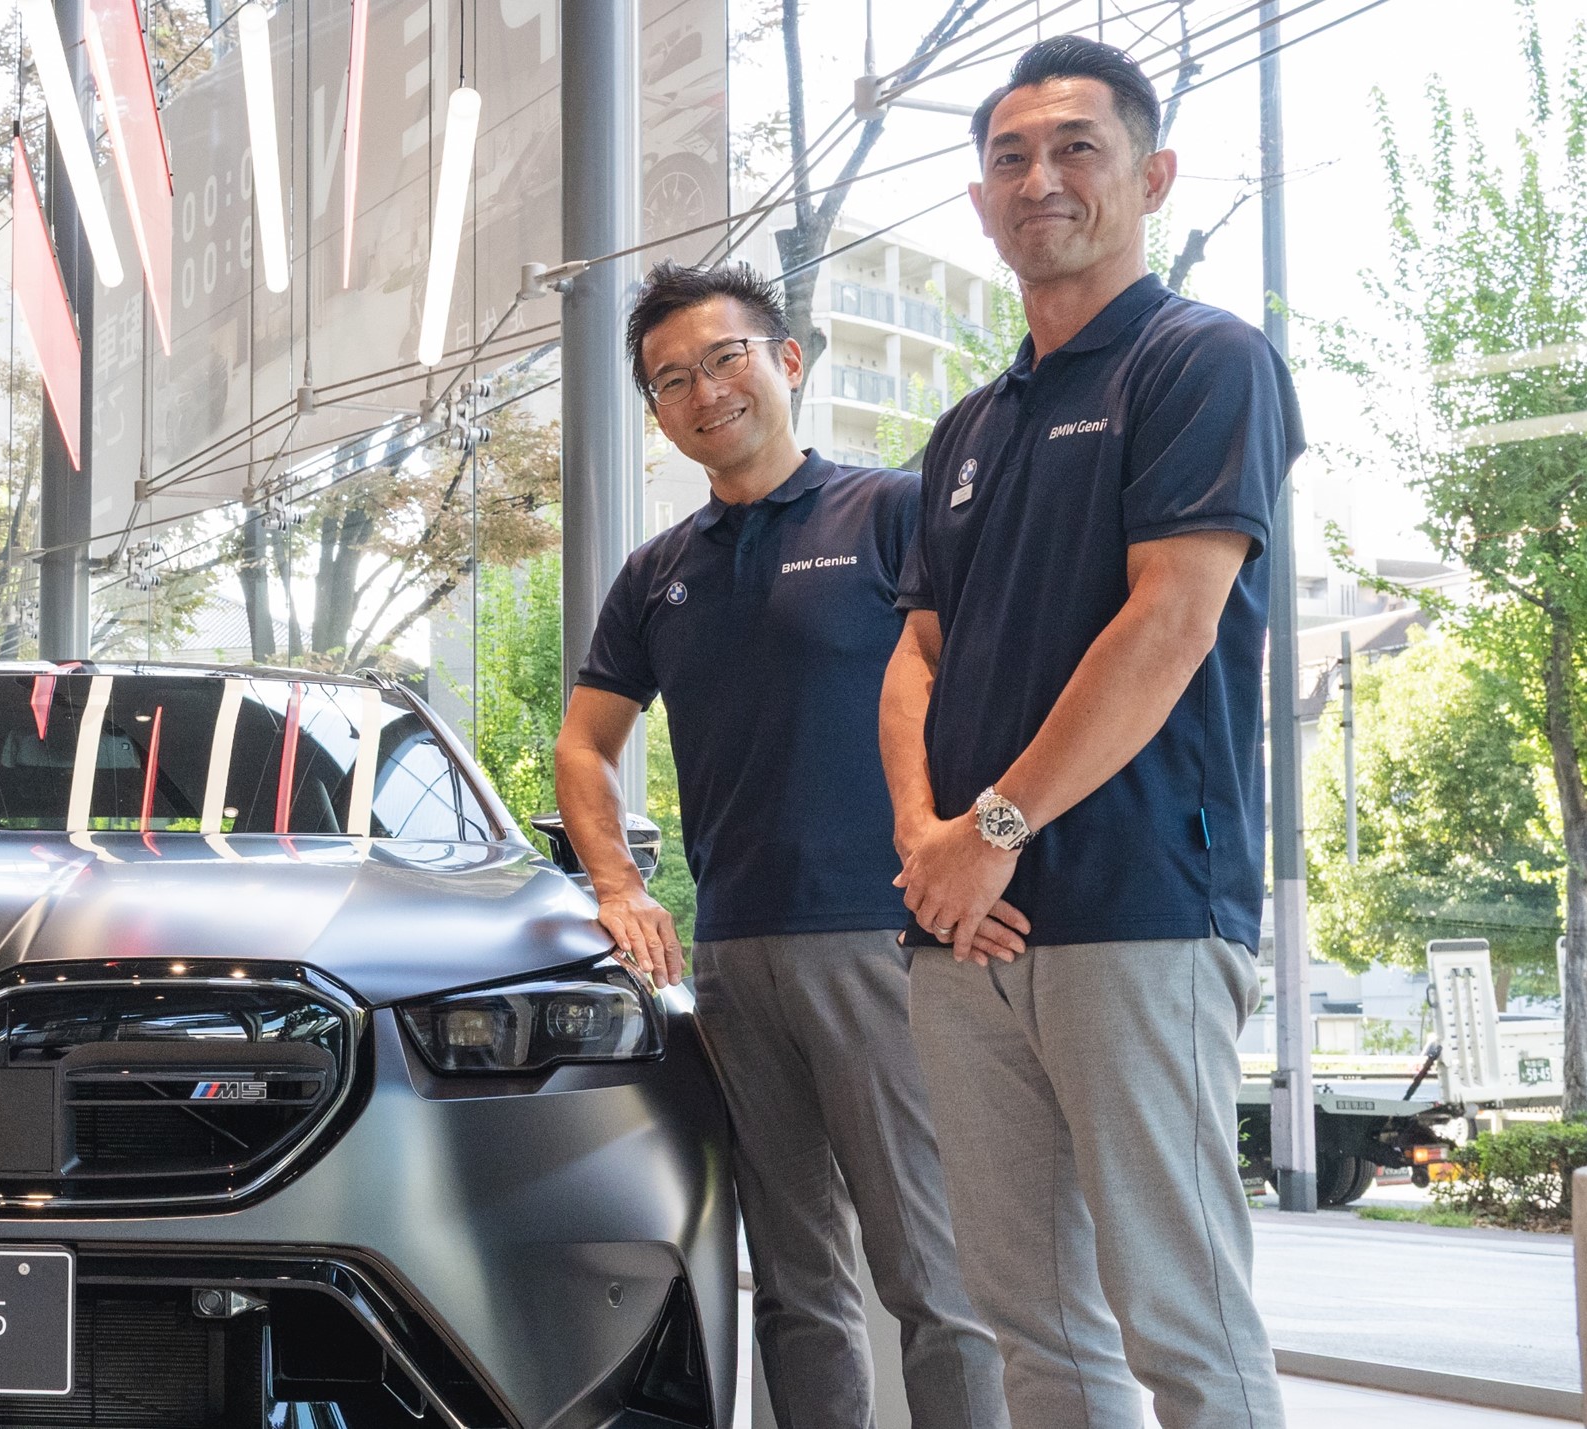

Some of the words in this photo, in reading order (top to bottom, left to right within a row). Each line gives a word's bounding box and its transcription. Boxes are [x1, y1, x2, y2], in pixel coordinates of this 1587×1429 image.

[1048, 421, 1078, 440] BMW
[781, 559, 814, 574] BMW
[814, 555, 858, 568] Genius
[211, 1081, 267, 1099] M5
